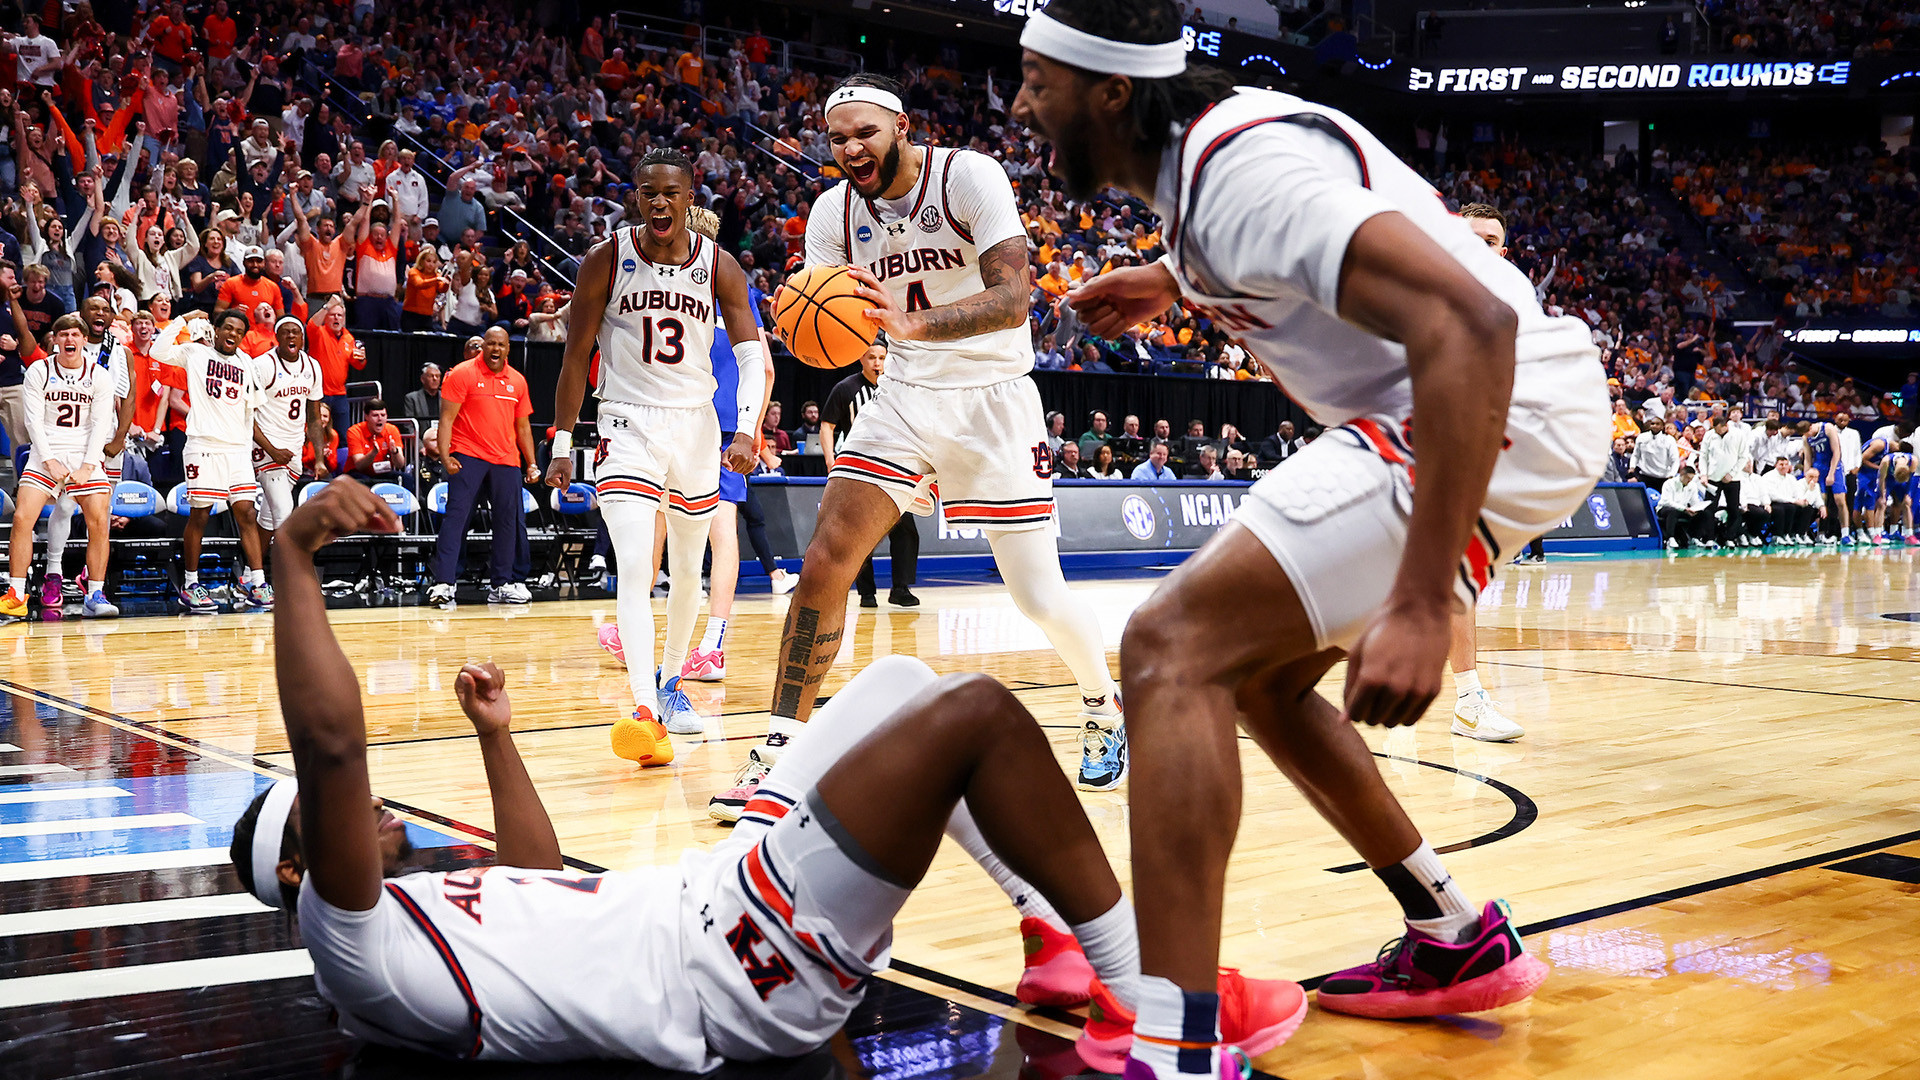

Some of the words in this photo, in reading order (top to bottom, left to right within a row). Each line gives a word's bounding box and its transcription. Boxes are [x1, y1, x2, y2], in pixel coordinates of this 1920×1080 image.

[1437, 67, 1528, 91] FIRST
[1531, 74, 1554, 85] AND
[1560, 64, 1681, 90] SECOND
[1687, 62, 1816, 88] ROUNDS
[869, 248, 966, 283] UBURN
[619, 290, 710, 324] AUBURN
[642, 316, 685, 365] 13
[206, 359, 244, 386] DOUBT
[45, 391, 94, 404] AUBURN
[206, 377, 222, 399] US
[56, 403, 80, 428] 21
[288, 398, 301, 420] 8
[1180, 494, 1235, 526] NCAA
